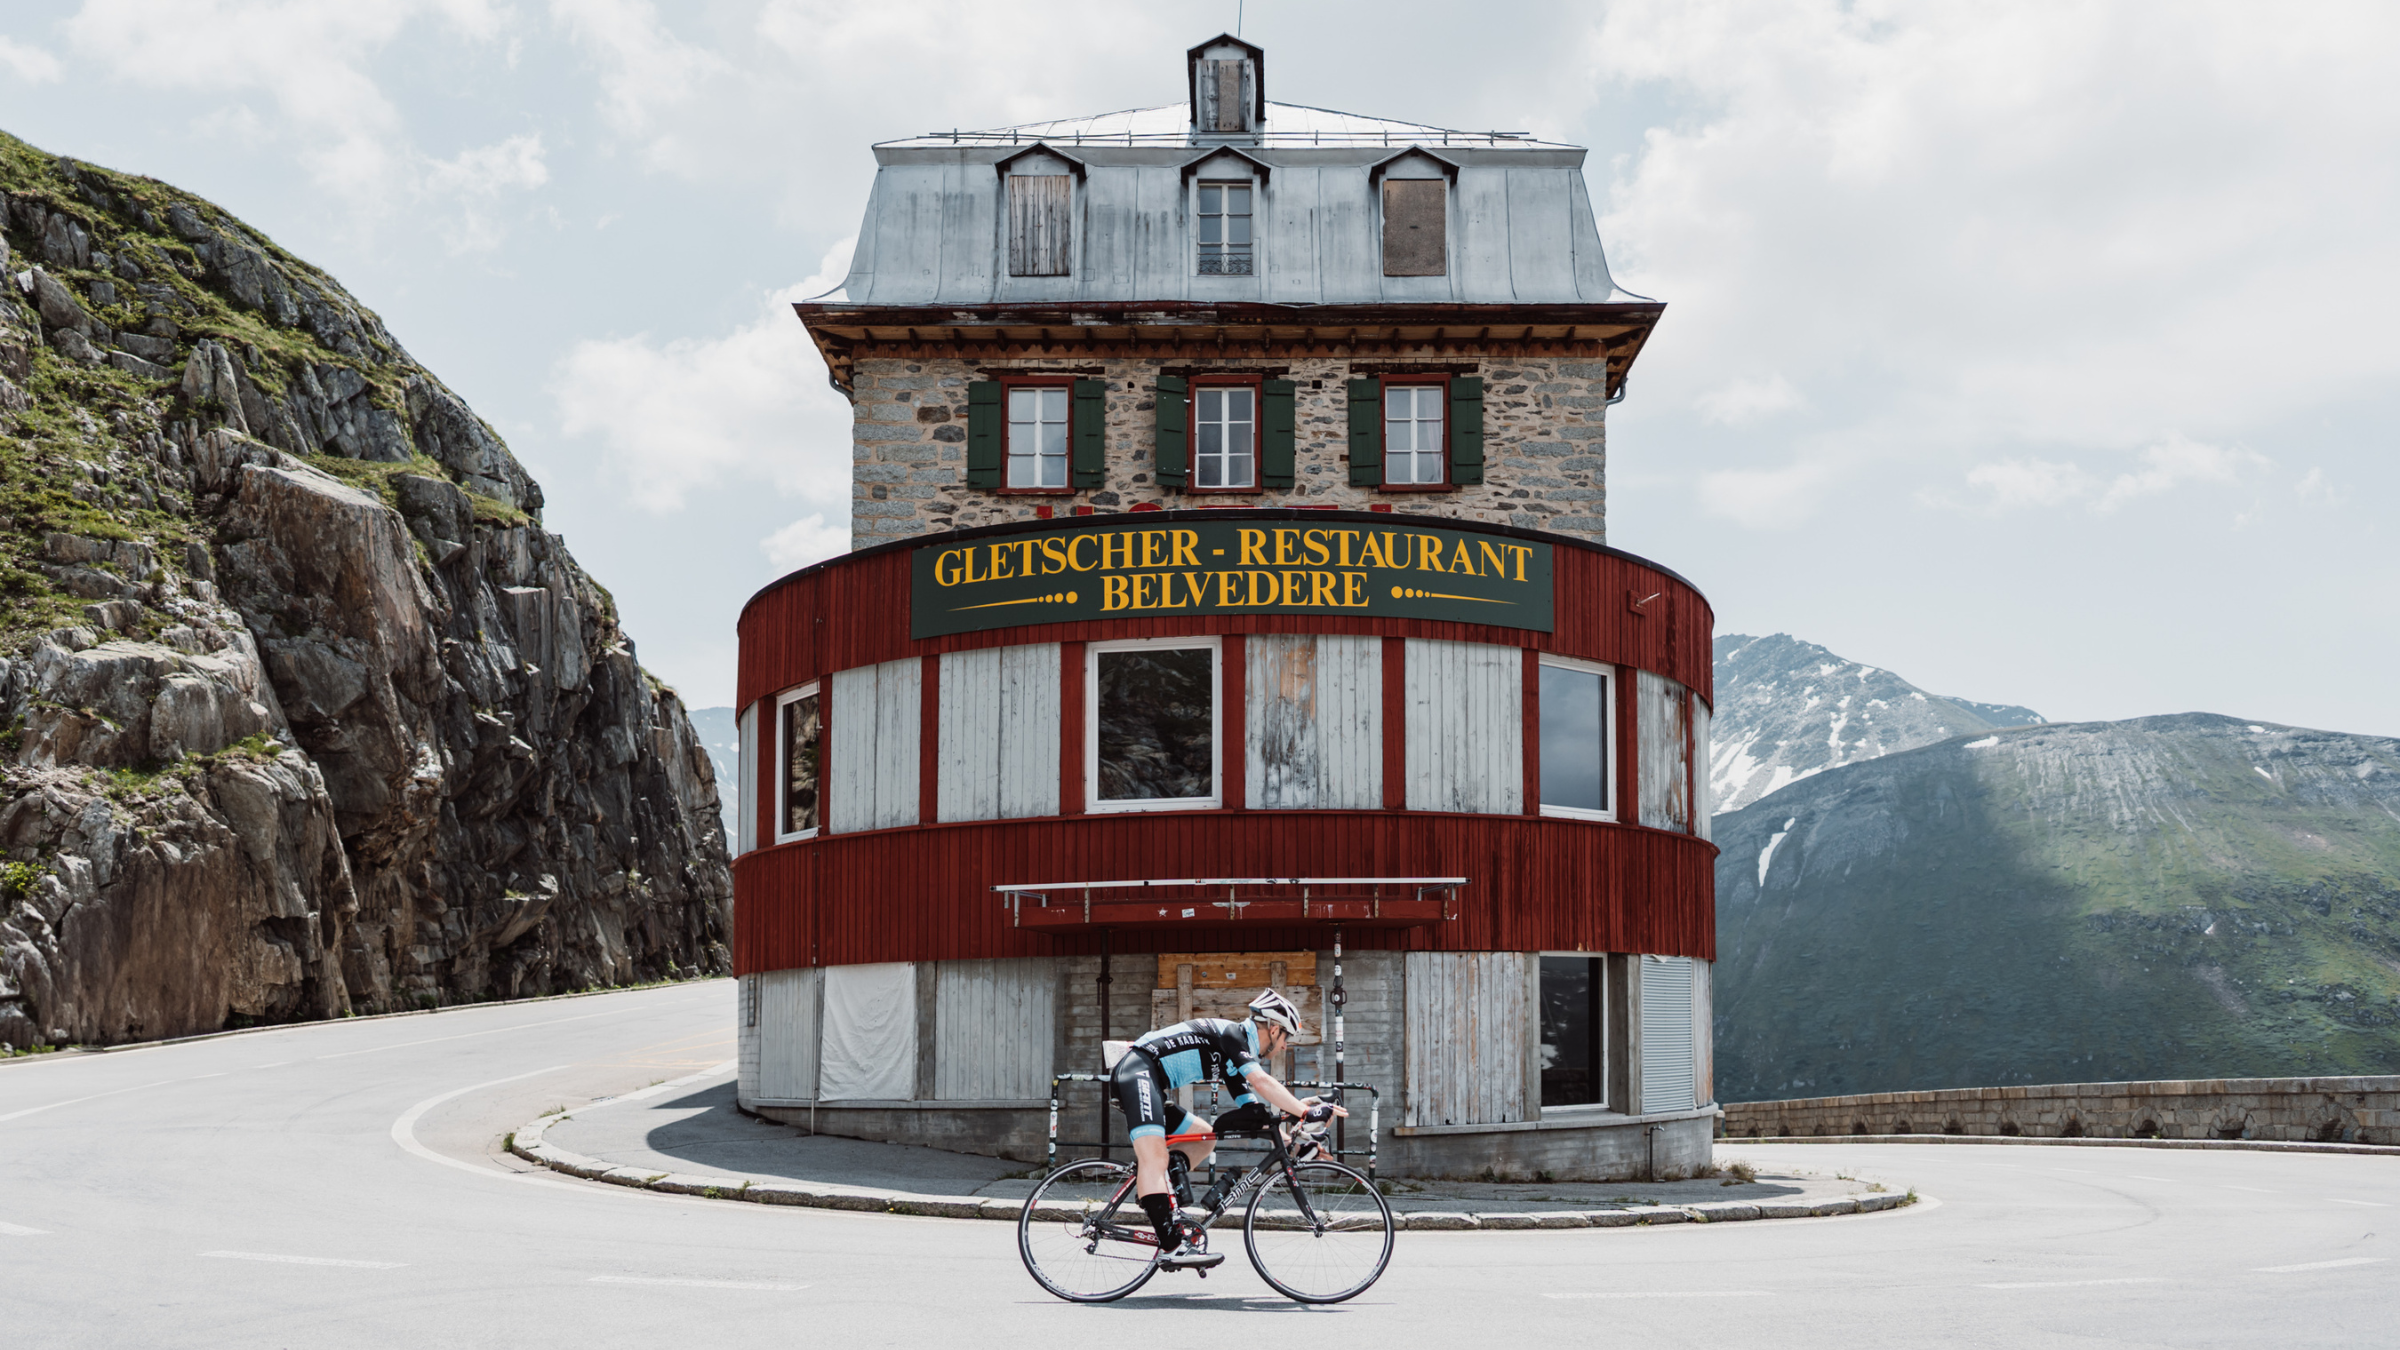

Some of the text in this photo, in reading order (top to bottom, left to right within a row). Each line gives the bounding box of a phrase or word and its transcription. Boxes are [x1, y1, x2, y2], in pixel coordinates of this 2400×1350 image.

[934, 528, 1203, 588] GLETSCHER
[1236, 528, 1533, 582] RESTAURANT
[1099, 570, 1370, 612] BELVEDERE
[1140, 1078, 1154, 1122] GIANT
[1217, 1166, 1263, 1212] BMC
